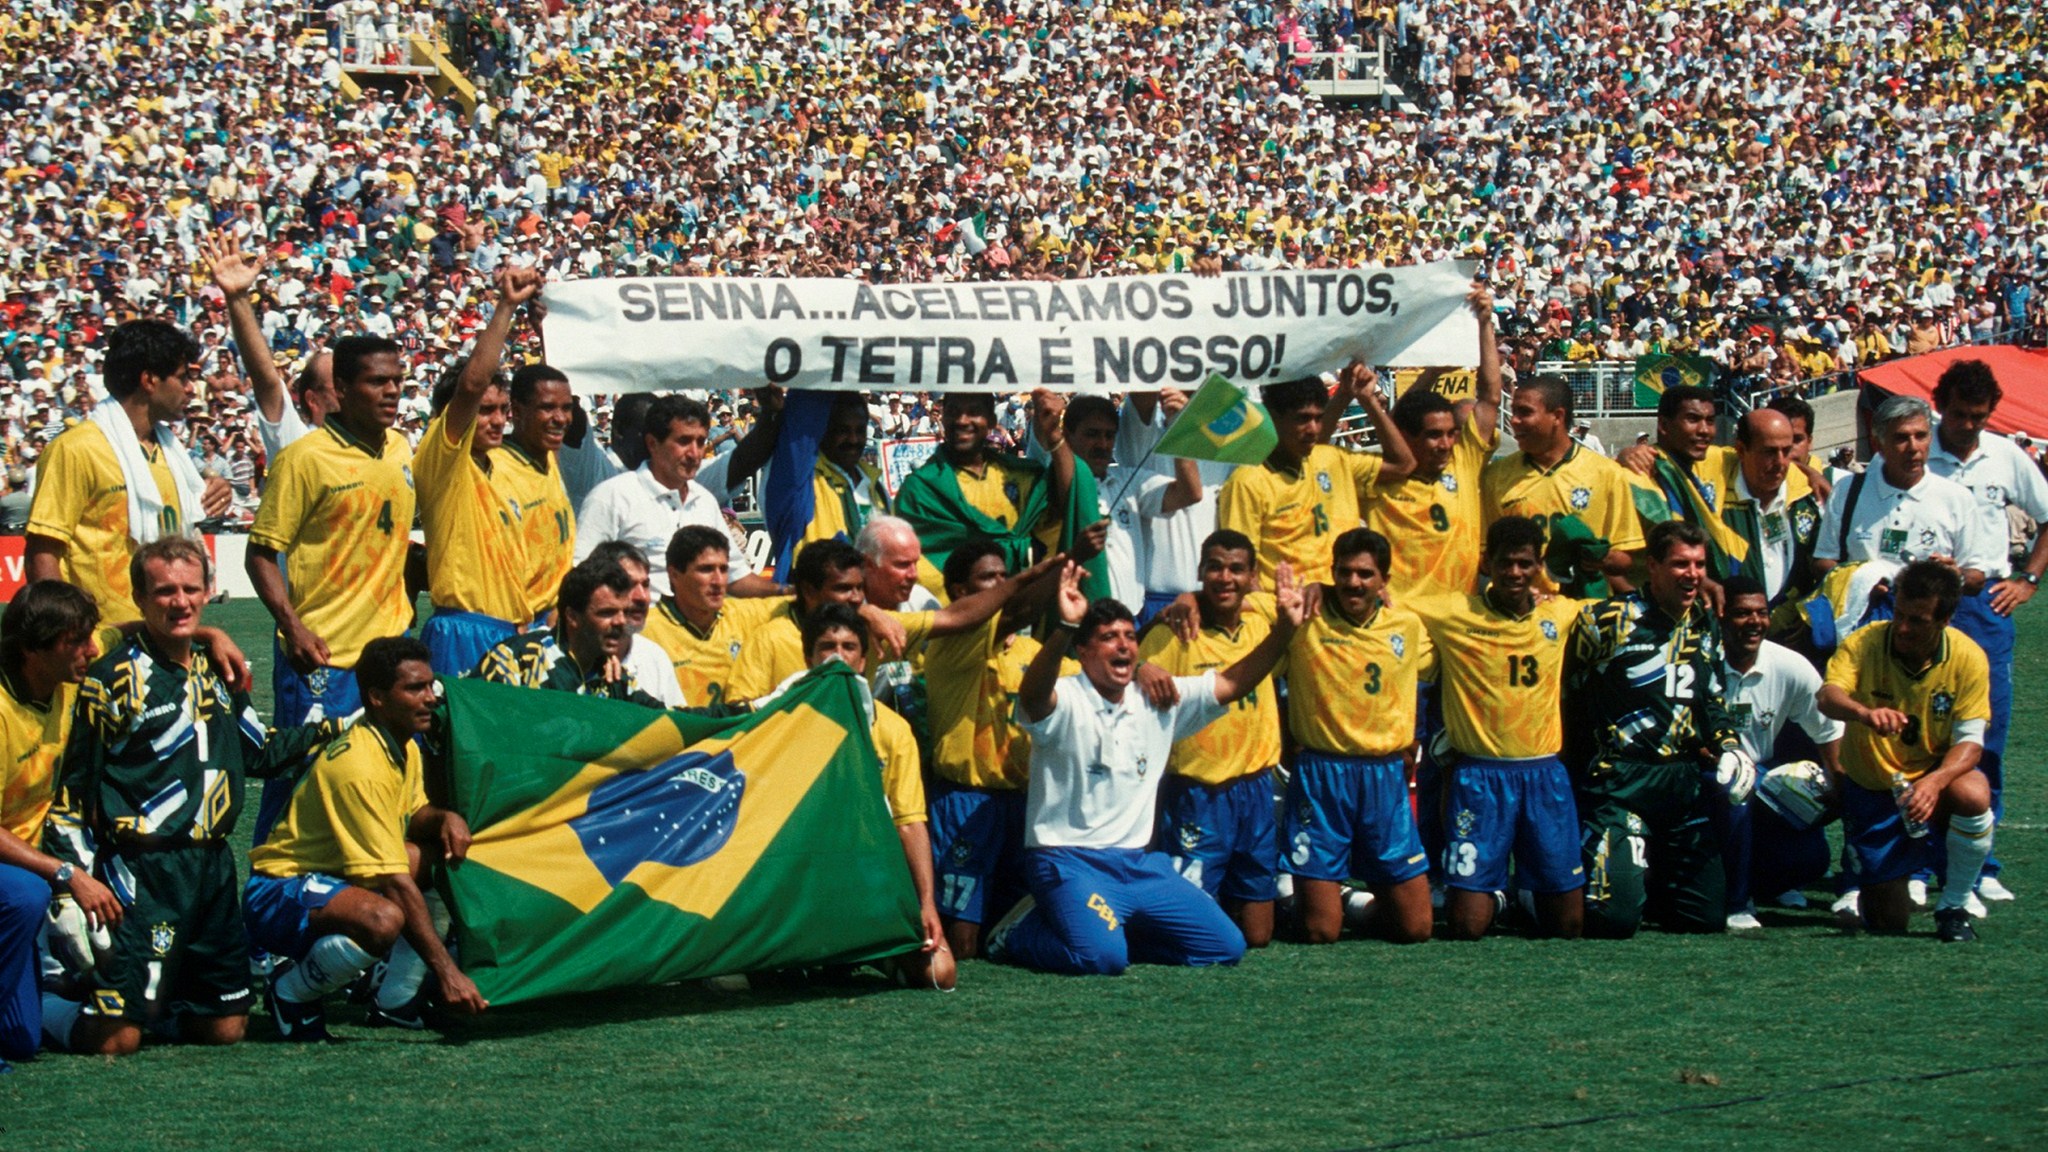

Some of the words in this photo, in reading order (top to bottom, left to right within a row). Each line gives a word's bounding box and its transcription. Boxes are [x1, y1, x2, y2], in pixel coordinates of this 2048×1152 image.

[1213, 272, 1399, 317] JUNTOS,
[764, 336, 802, 383] O
[821, 336, 1018, 384] TETRA
[1040, 327, 1075, 385] É
[1094, 333, 1286, 384] NOSSO!
[377, 499, 394, 536] 4
[1430, 503, 1449, 532] 9
[1363, 662, 1381, 695] 3
[1507, 654, 1538, 688] 13
[1664, 663, 1695, 699] 12
[193, 719, 209, 762] 1
[676, 769, 726, 790] RES
[1292, 831, 1311, 866] 3
[1442, 841, 1478, 877] 13
[1626, 835, 1649, 868] 12
[942, 873, 976, 912] 17
[144, 961, 162, 1001] 1
